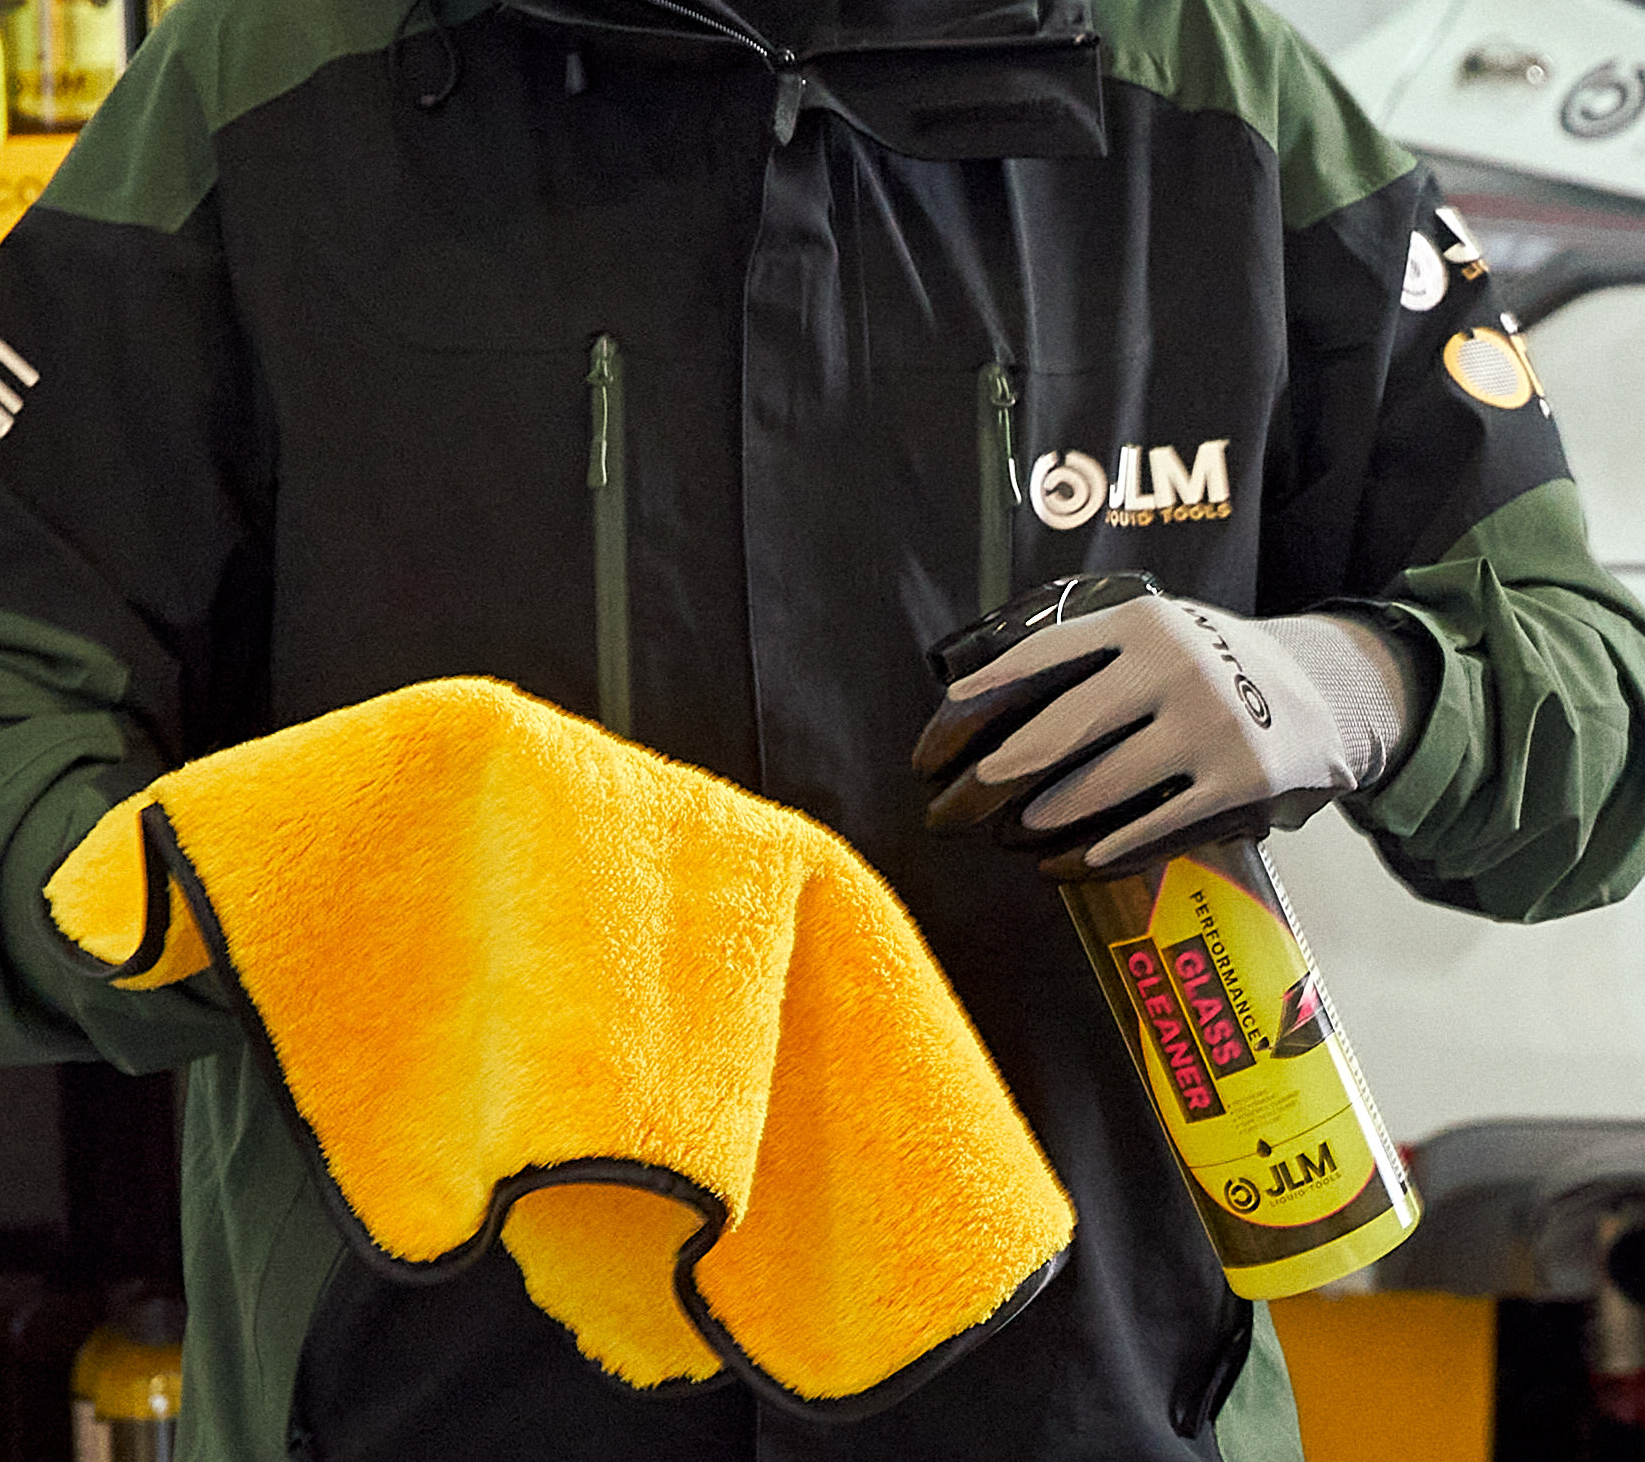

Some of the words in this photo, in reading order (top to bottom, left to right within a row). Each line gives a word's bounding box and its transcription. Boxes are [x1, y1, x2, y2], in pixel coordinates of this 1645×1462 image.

[1109, 439, 1230, 512] JLM
[1174, 949, 1242, 1066] GLASS
[1189, 889, 1262, 1042] PERFORMANCE
[1128, 951, 1212, 1111] CLEANER
[1265, 1141, 1338, 1198] JLM
